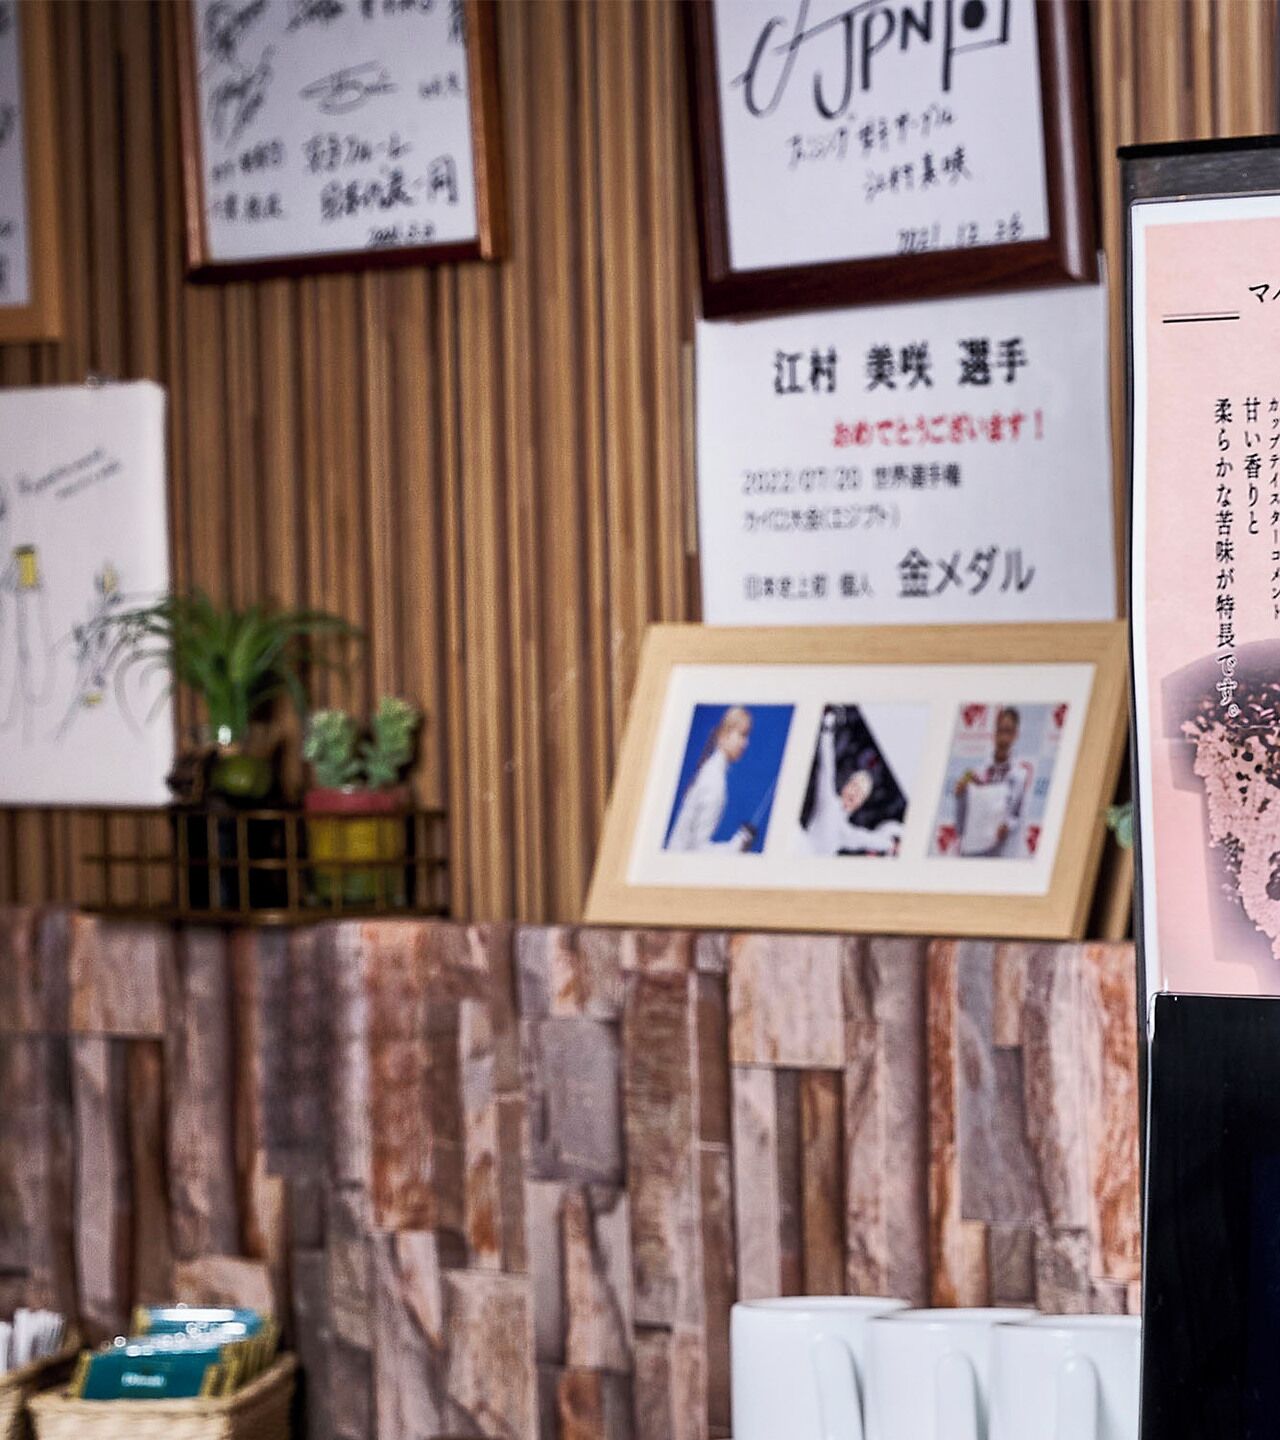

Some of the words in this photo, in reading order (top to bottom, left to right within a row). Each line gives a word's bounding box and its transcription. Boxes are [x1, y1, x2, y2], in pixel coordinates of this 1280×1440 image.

[774, 347, 837, 395] 江村
[866, 341, 932, 391] 美咲
[958, 337, 1027, 386] 選手
[873, 463, 962, 490] 世界選手権
[1243, 396, 1261, 536] 甘い香りと
[896, 546, 1036, 598] 金メダル
[1213, 398, 1240, 718] 柔らかな苦味が特長です。
